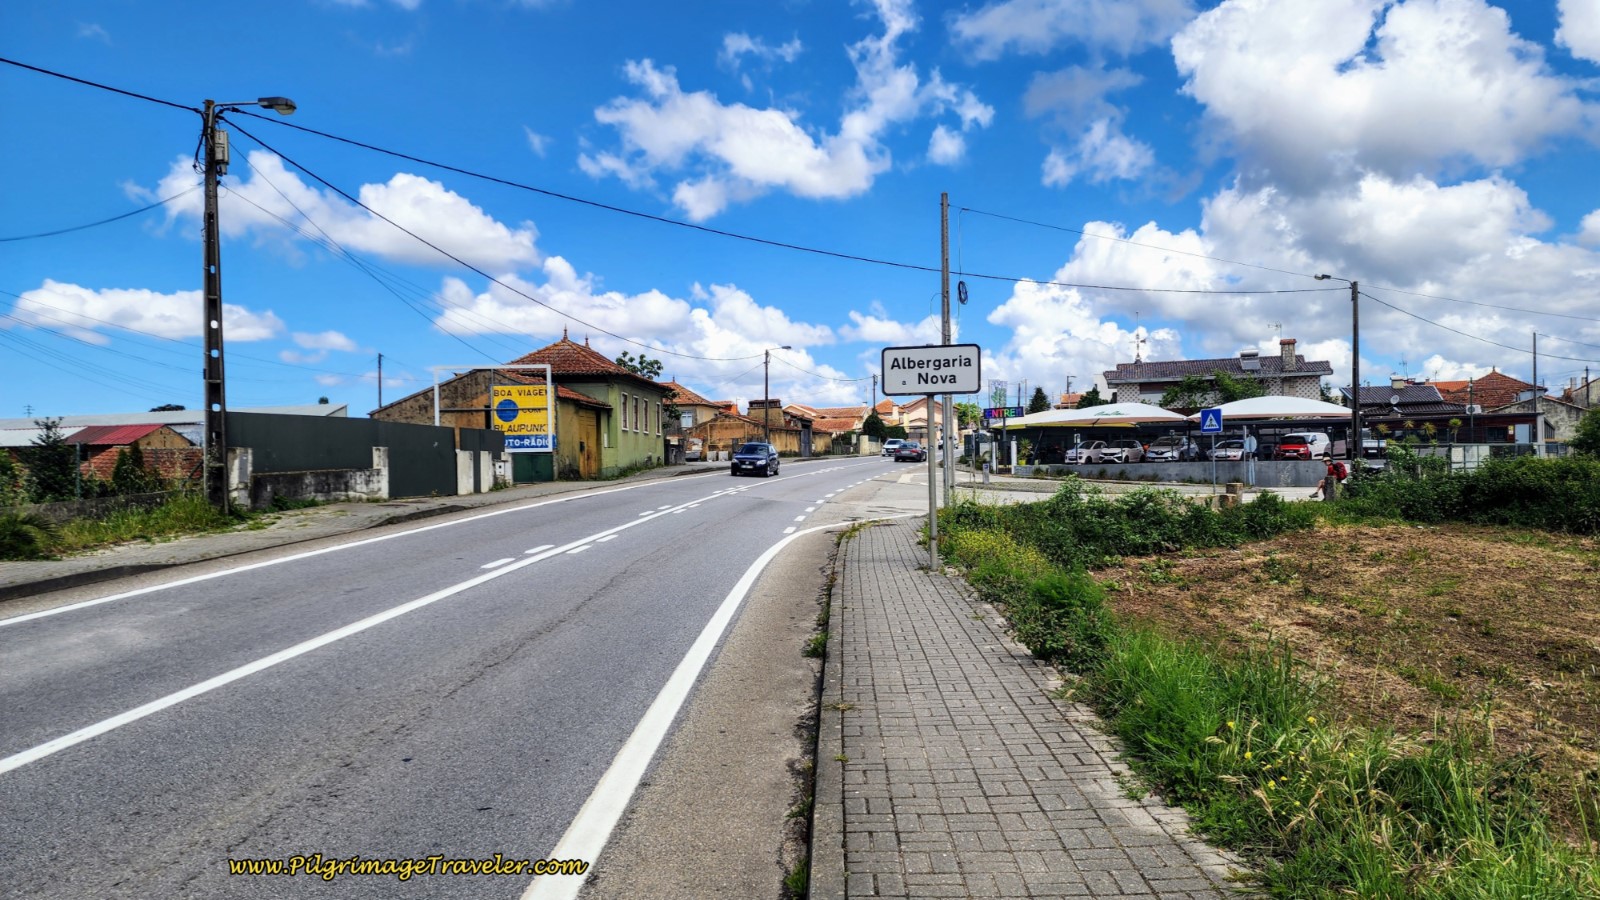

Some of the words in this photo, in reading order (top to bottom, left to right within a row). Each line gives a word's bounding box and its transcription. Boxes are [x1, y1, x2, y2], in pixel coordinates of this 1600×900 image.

[890, 355, 972, 371] Albergaria
[917, 372, 957, 385] Nova
[493, 389, 513, 397] BOA
[517, 388, 547, 397] VIAGE
[494, 423, 548, 433] BLAUPUNK
